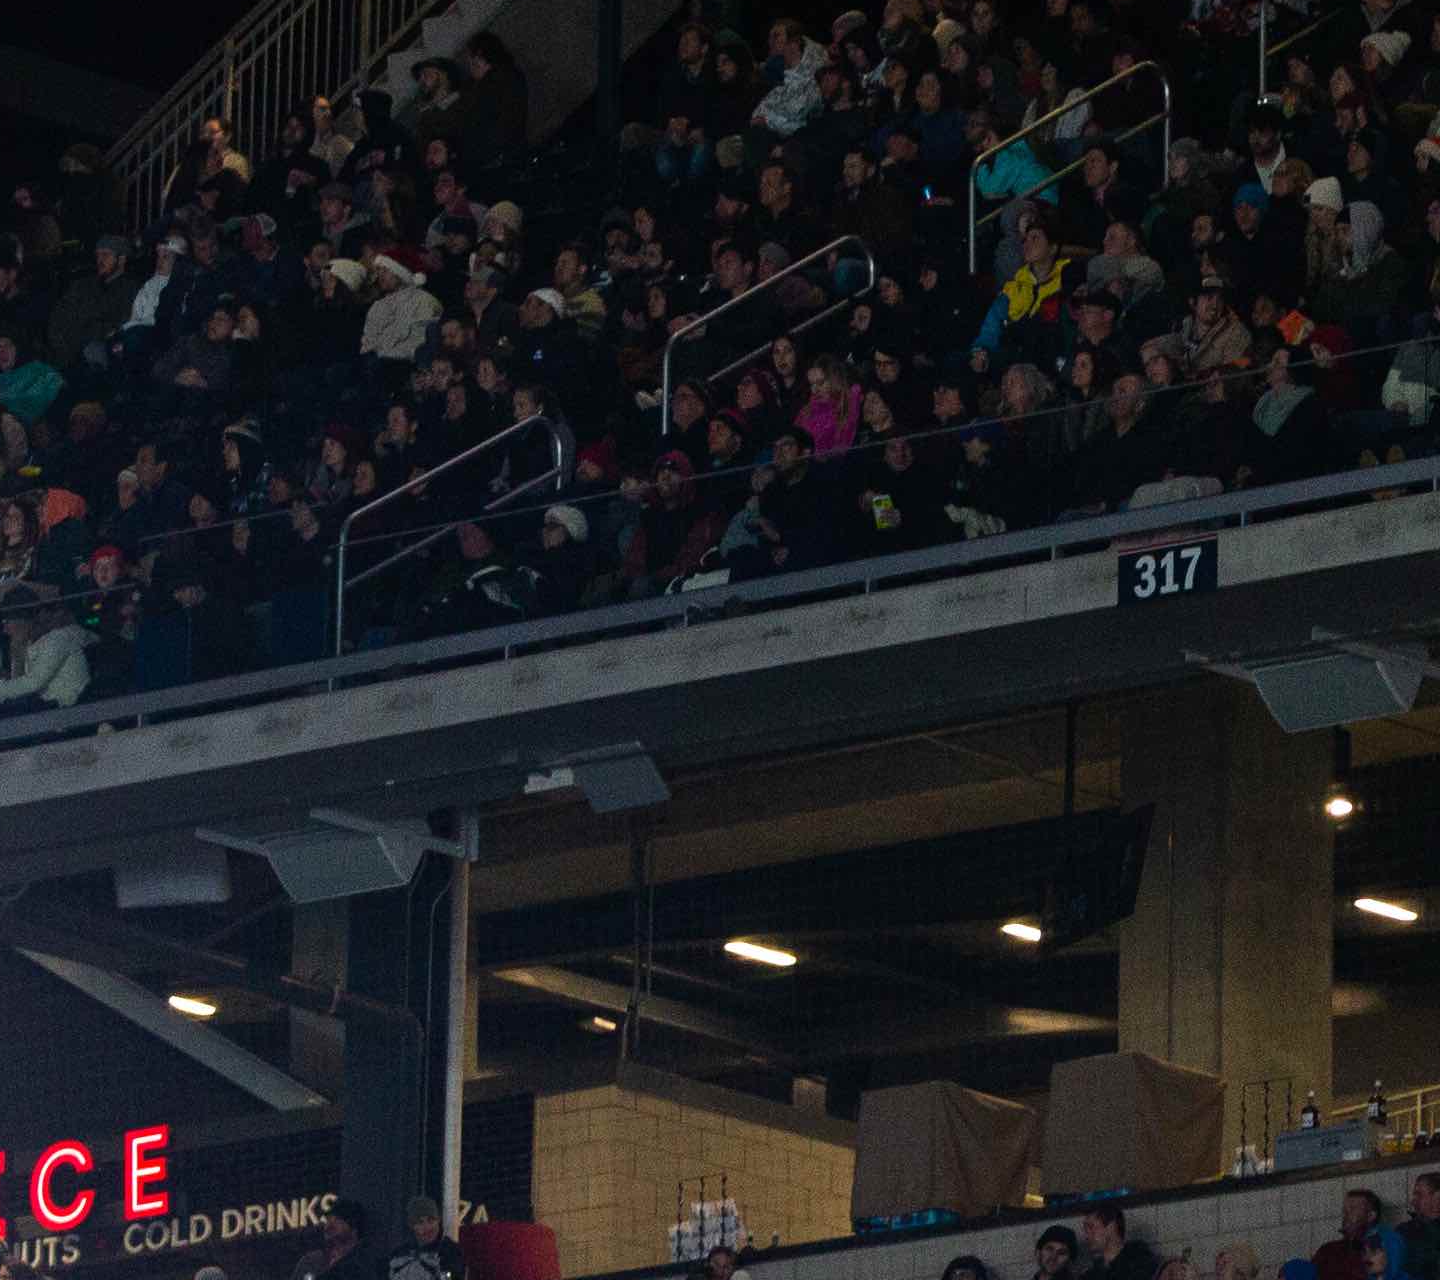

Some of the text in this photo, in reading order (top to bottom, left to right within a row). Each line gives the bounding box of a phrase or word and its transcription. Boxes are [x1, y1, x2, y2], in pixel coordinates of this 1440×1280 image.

[1133, 546, 1202, 599] 317
[123, 1213, 212, 1255] COLD
[221, 1193, 338, 1240] DRINKS
